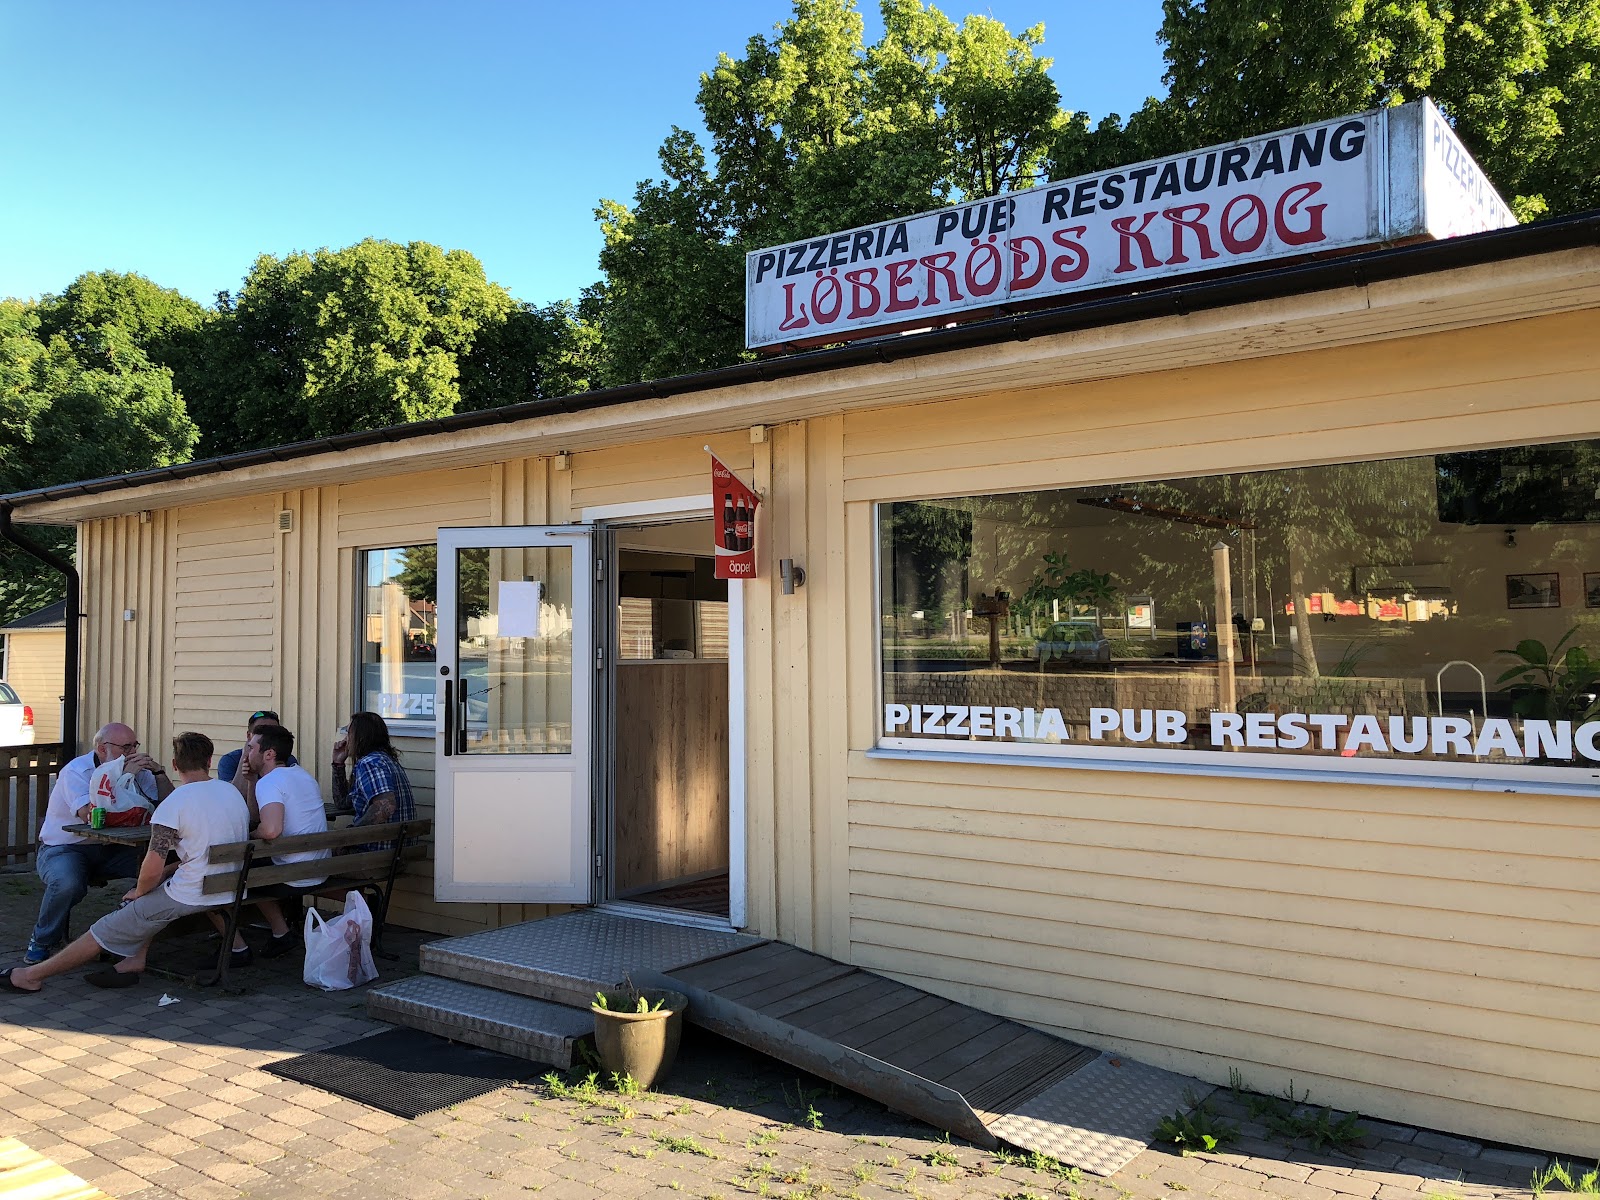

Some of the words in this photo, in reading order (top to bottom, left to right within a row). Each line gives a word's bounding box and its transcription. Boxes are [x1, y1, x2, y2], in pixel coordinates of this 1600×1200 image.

[756, 223, 909, 284] PIZZERIA
[934, 197, 1016, 246] PUB
[1042, 120, 1366, 225] RESTAURANG
[1434, 119, 1484, 212] PIZZERIA
[778, 225, 1090, 331] LÖBERÖDS
[1111, 181, 1328, 274] KROG
[378, 693, 436, 715] PIZZE
[885, 703, 1070, 740] PIZZERIA
[1089, 707, 1188, 743] PUB
